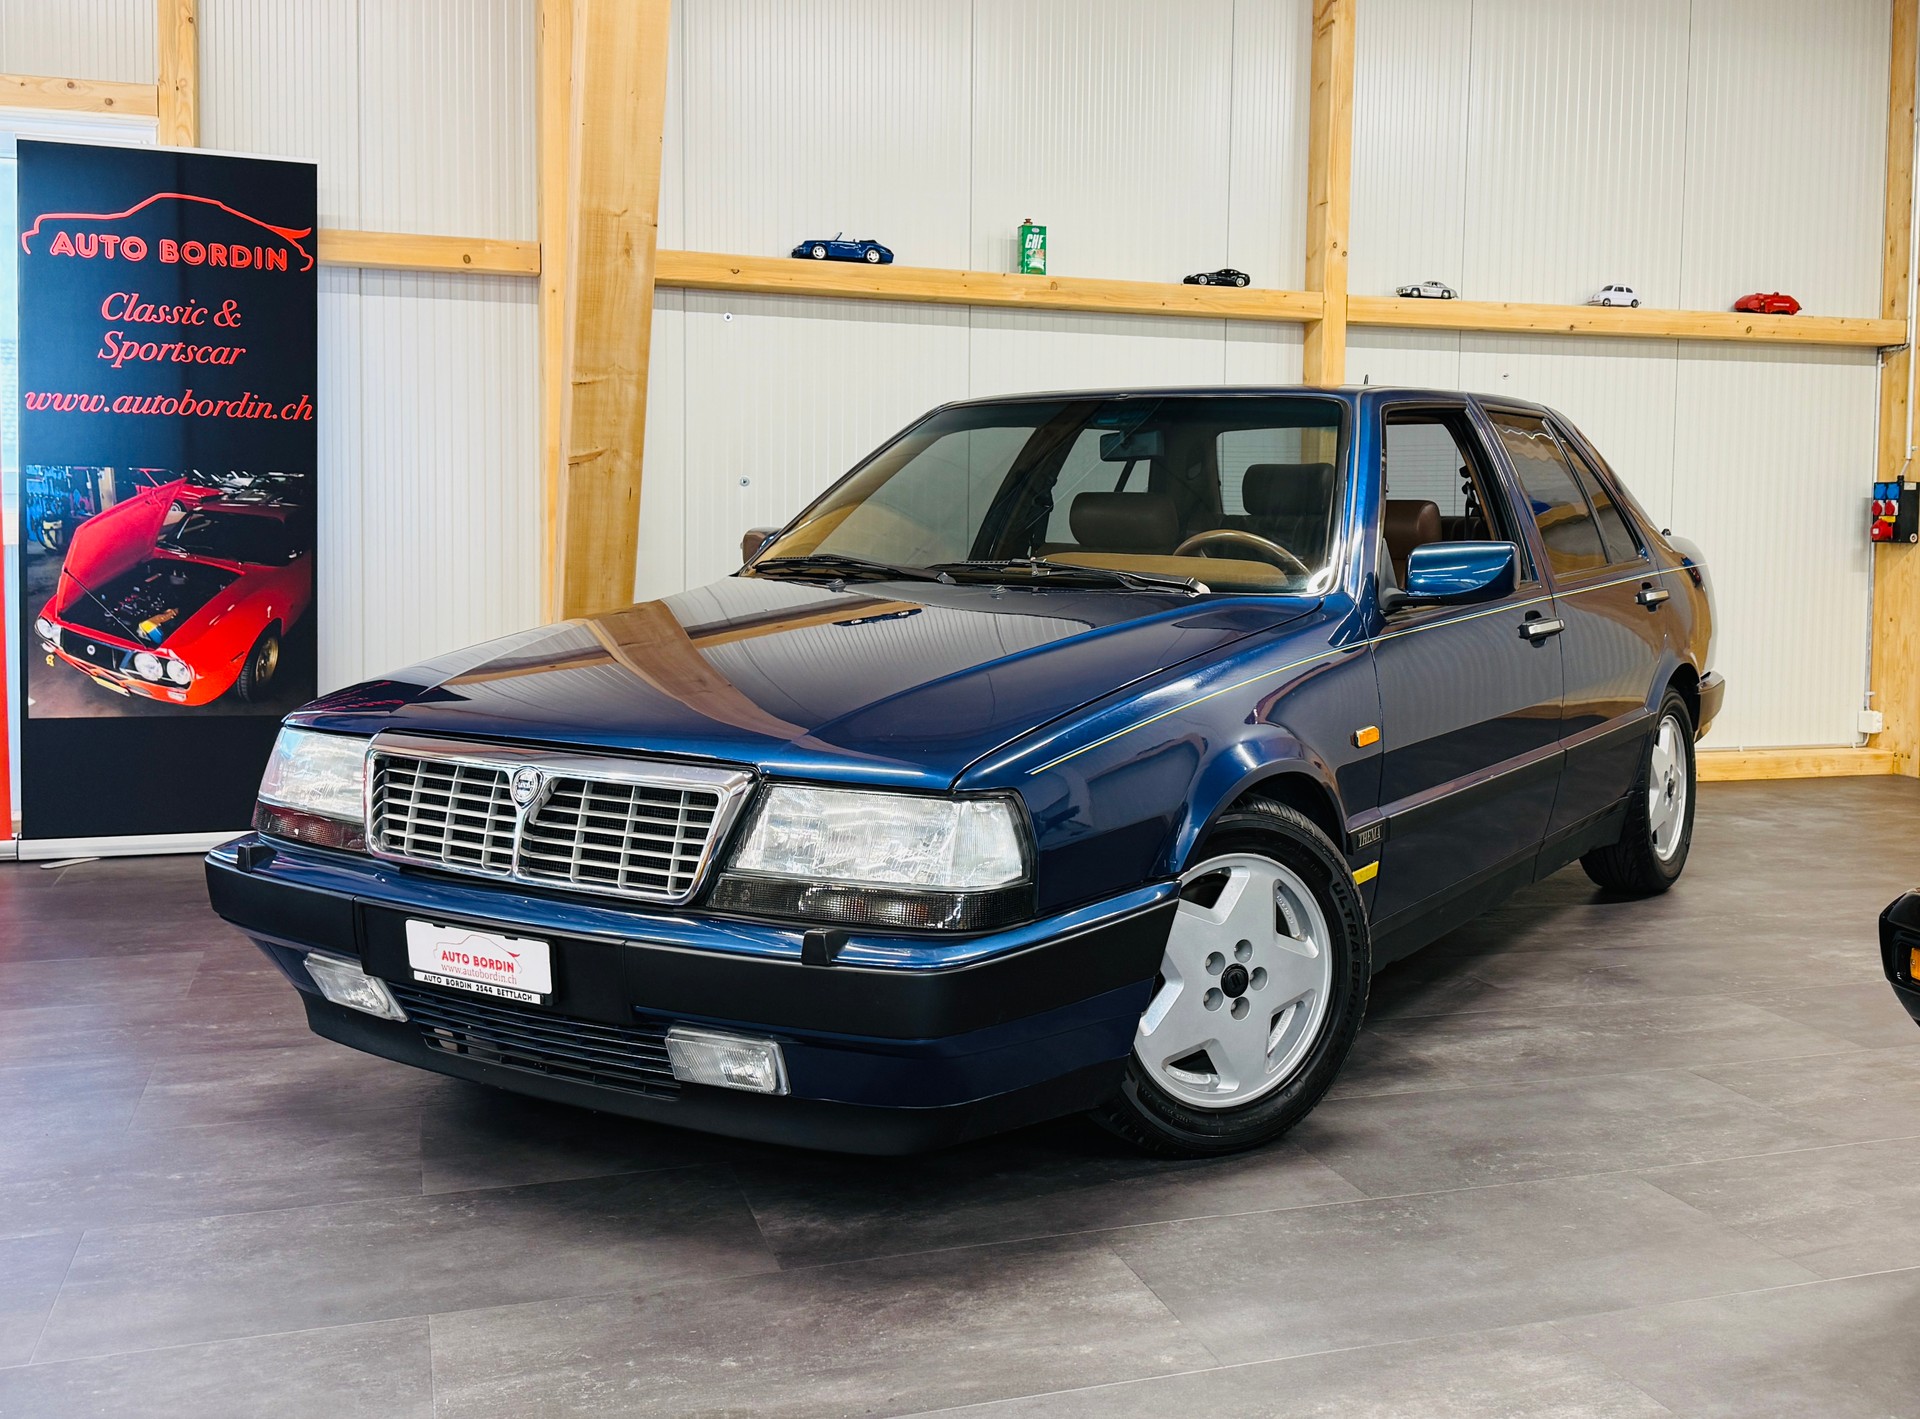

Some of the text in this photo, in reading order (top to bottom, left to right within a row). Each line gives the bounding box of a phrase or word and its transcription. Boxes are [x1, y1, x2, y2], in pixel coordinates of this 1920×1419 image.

[49, 231, 288, 272] AUTO BORDIN
[101, 292, 242, 328] Classic &
[97, 331, 247, 369] Sportscar
[24, 389, 313, 421] www.autobordin.ch
[1358, 825, 1381, 847] THEMA
[441, 964, 517, 985] www.autobordin.ch
[442, 950, 515, 973] AUTO BORDIN
[423, 974, 442, 983] AUTO
[446, 978, 472, 989] BORDIN
[497, 989, 533, 1001] BETTLACH
